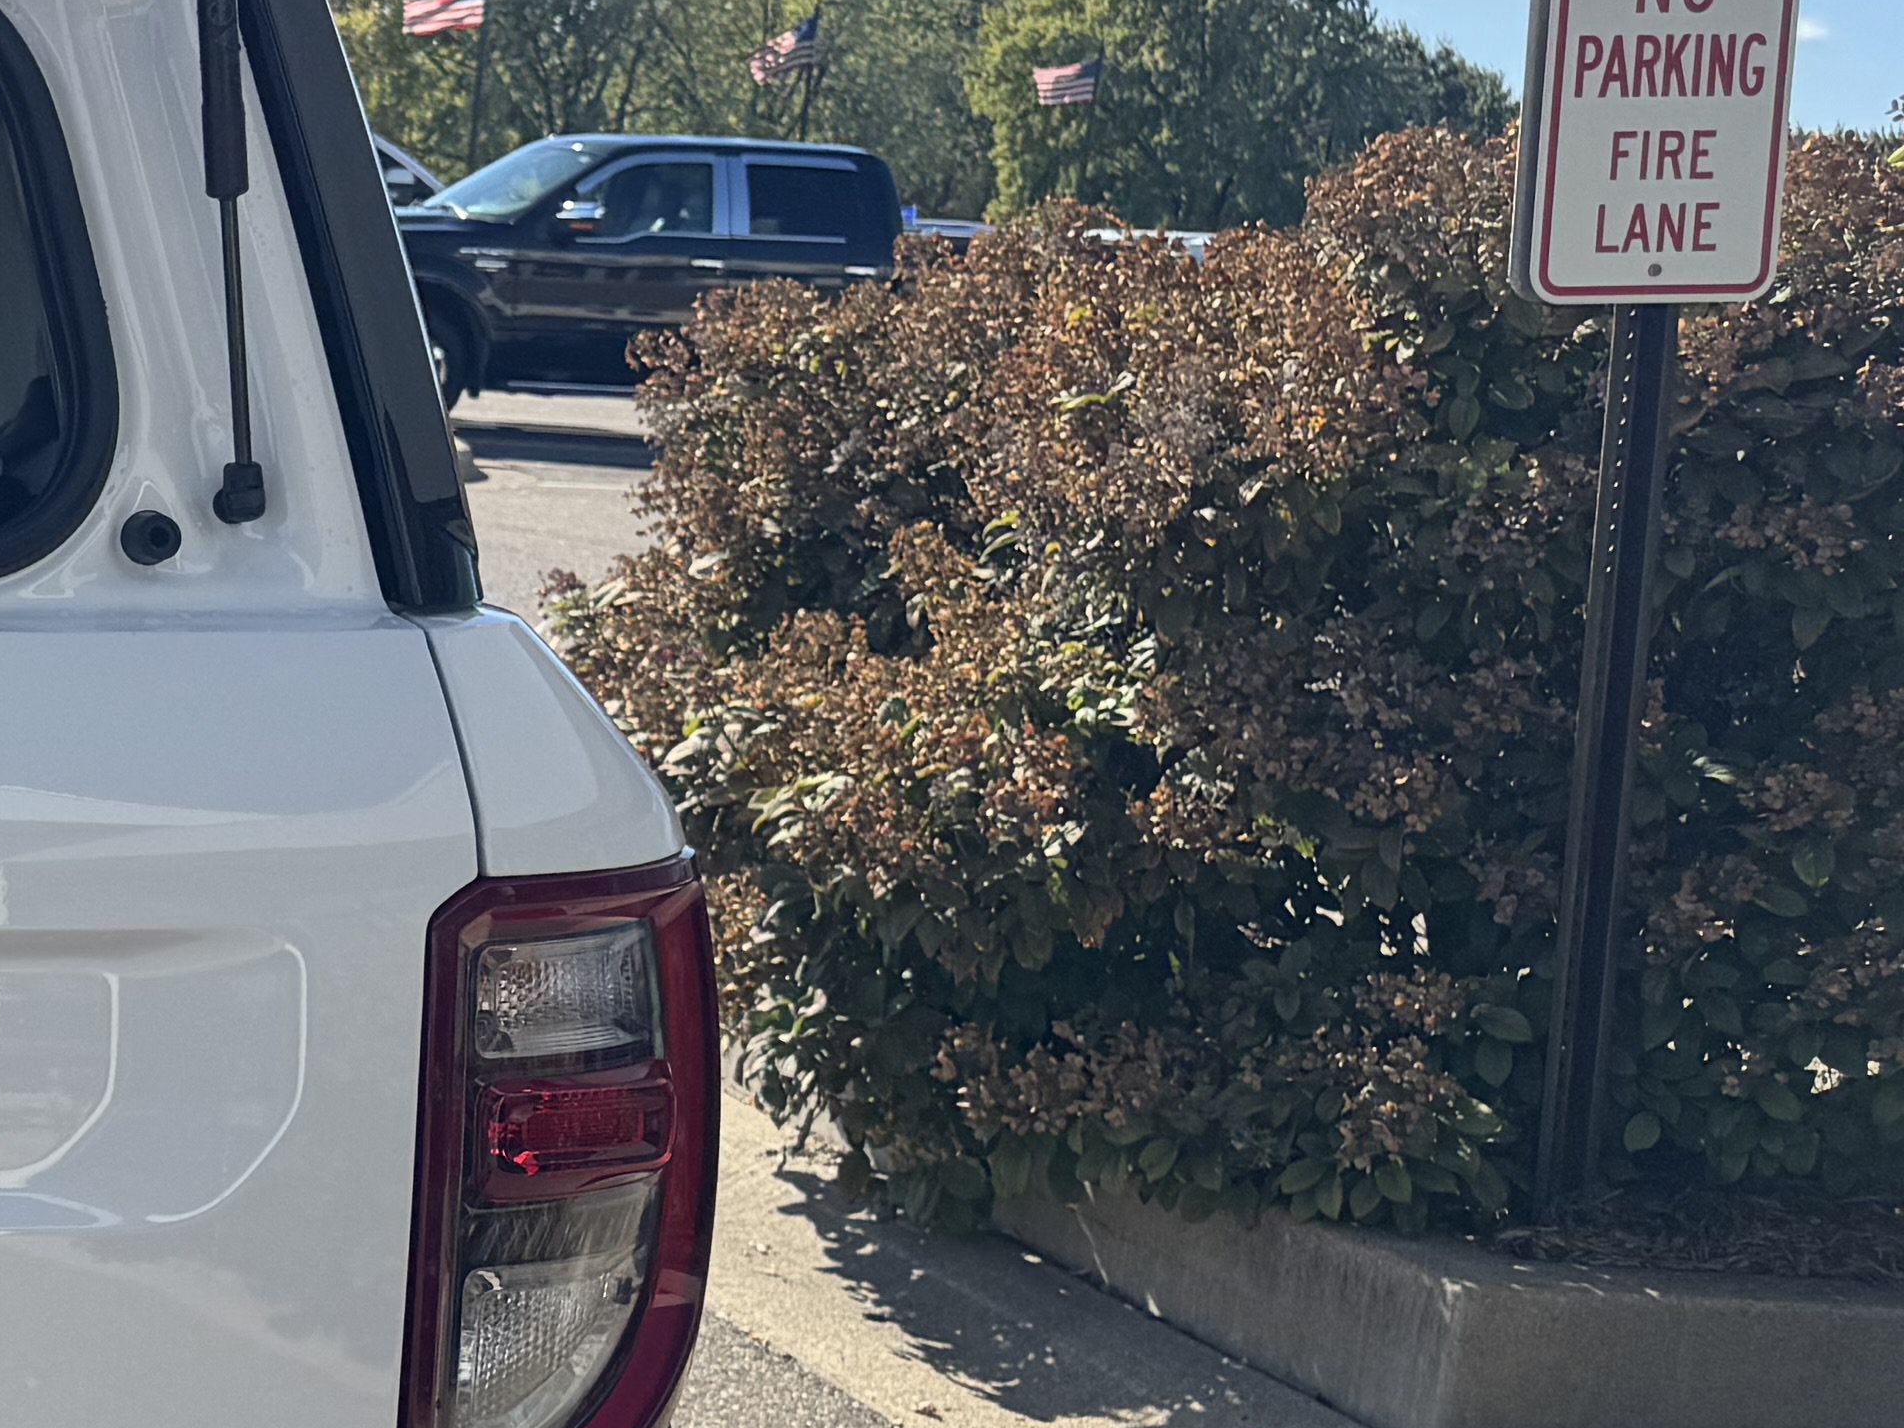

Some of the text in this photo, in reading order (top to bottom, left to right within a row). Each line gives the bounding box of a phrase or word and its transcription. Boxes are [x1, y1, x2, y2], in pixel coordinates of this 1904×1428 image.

[1573, 32, 1768, 99] PARKING
[1608, 129, 1718, 182] FIRE
[1594, 201, 1721, 254] LANE
